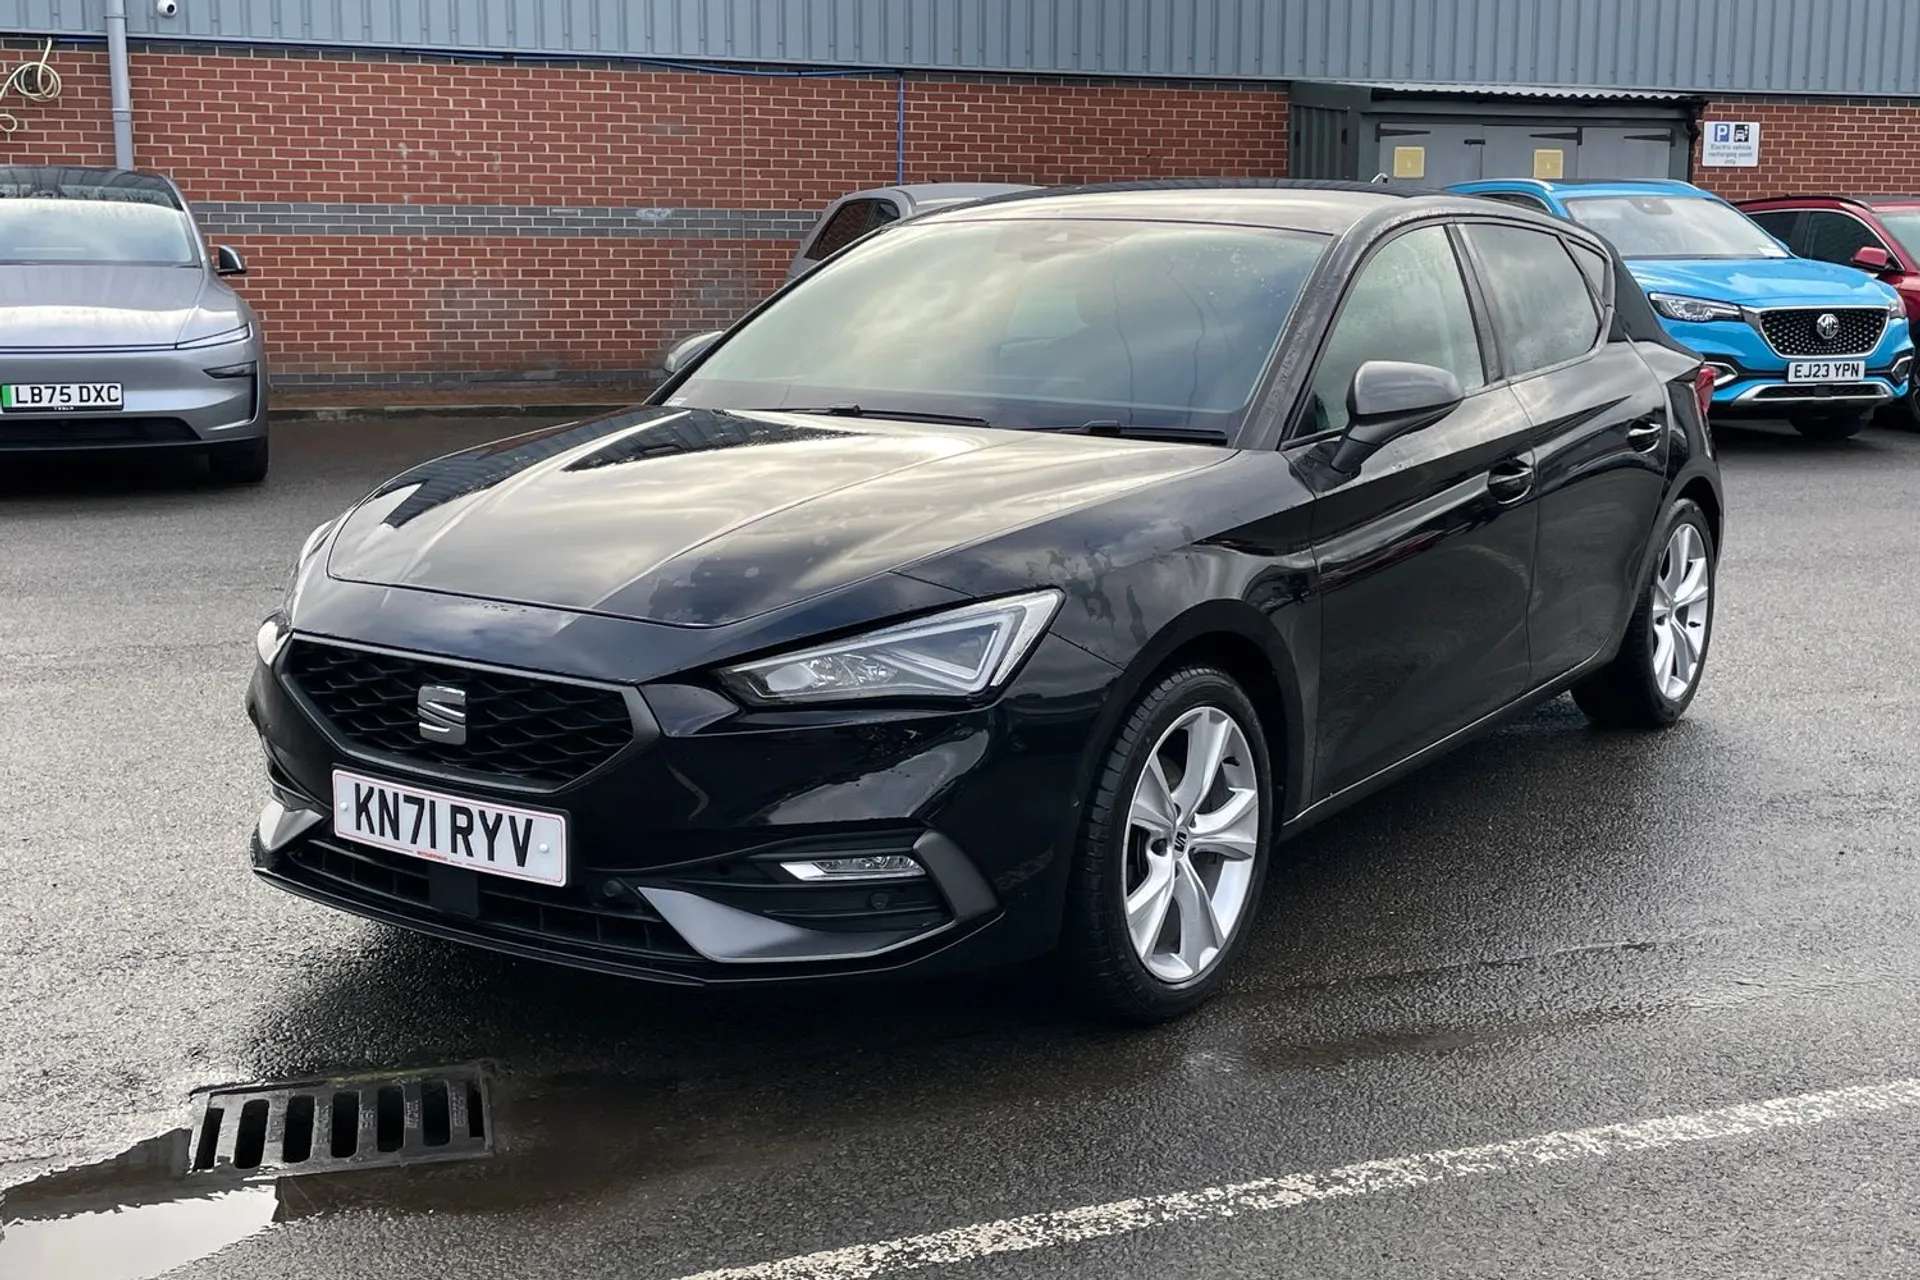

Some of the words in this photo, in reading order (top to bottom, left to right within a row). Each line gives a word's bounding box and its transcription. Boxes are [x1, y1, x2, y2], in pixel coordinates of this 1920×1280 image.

[1794, 364, 1829, 378] EJ23
[1832, 363, 1859, 377] YPN
[15, 386, 71, 404] LB75
[79, 385, 119, 403] DXC
[354, 782, 437, 850] KN71
[449, 803, 533, 868] RYV
